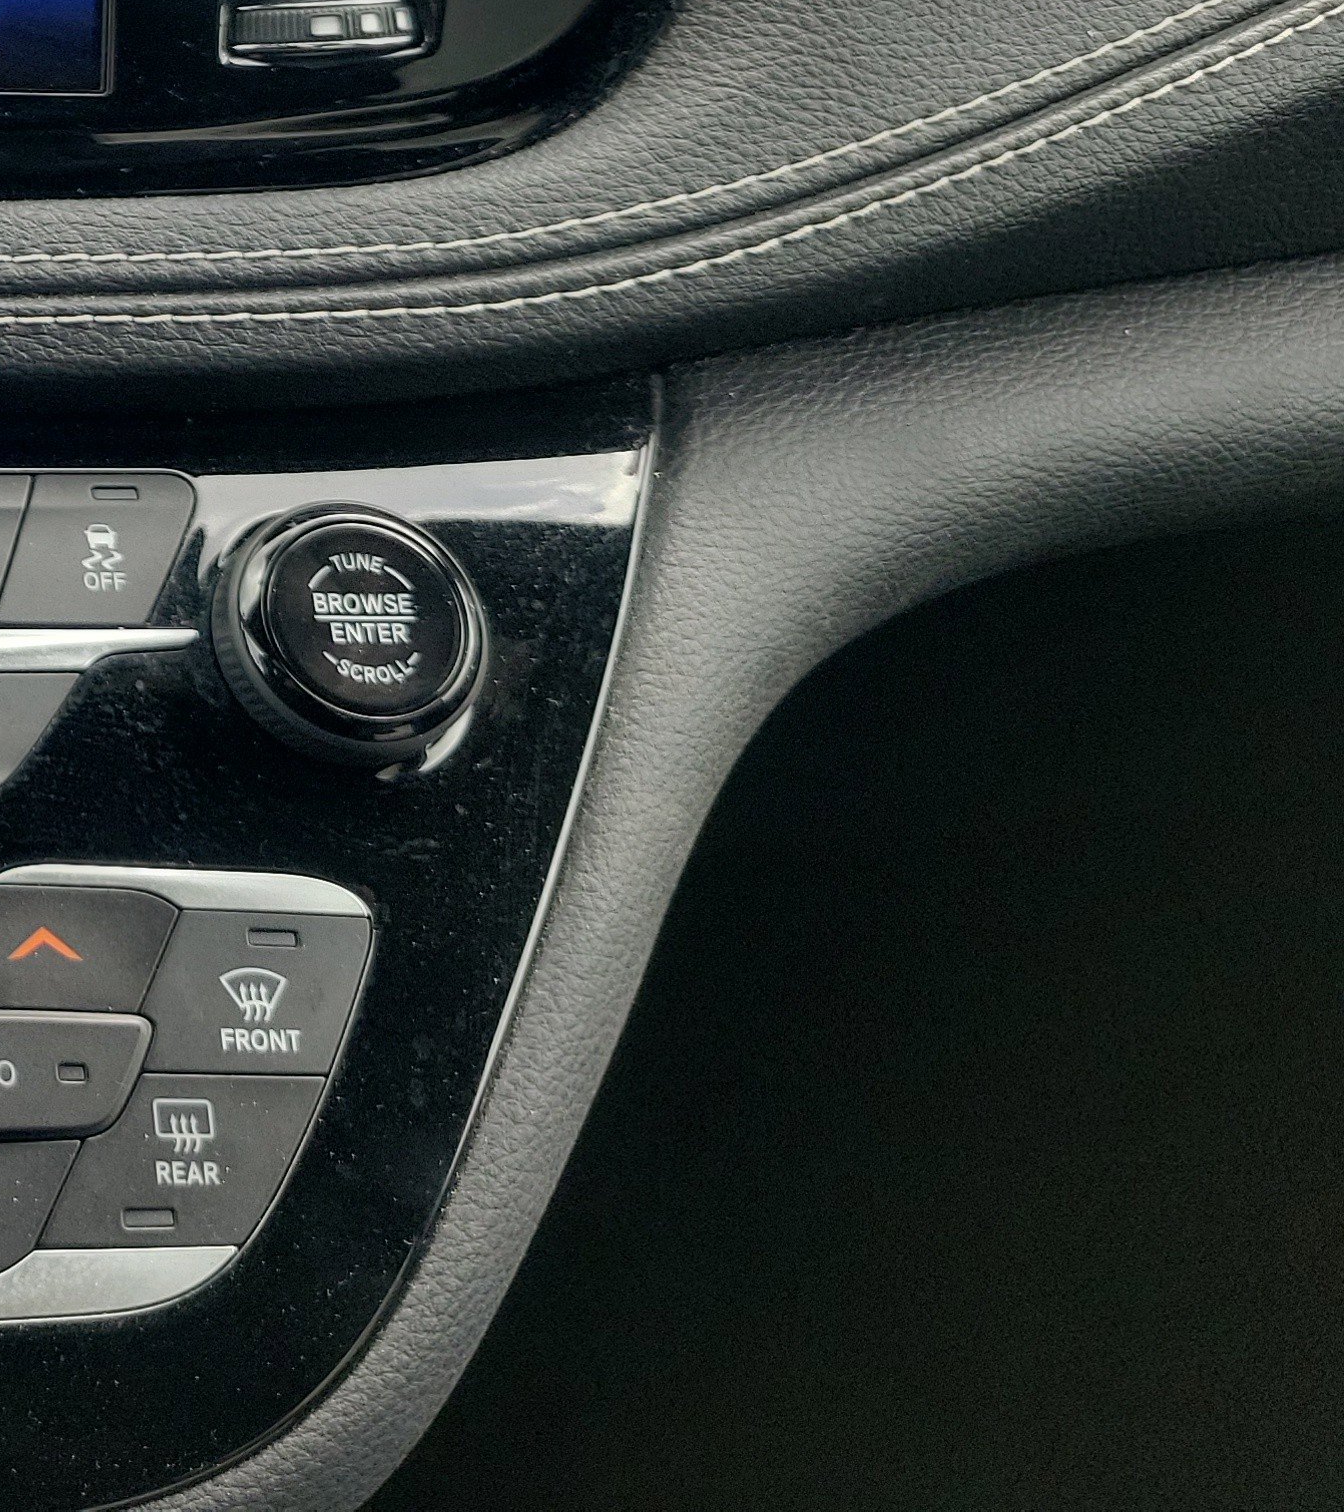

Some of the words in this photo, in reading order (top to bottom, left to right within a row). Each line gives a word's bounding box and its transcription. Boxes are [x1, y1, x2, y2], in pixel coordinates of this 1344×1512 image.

[329, 552, 386, 574] TUNE
[83, 571, 126, 591] OFF
[312, 592, 413, 616] BROWSE
[330, 622, 409, 645] ENTER
[335, 657, 410, 684] SCROLL
[221, 1028, 300, 1052] FRONT
[156, 1161, 220, 1185] REAR
